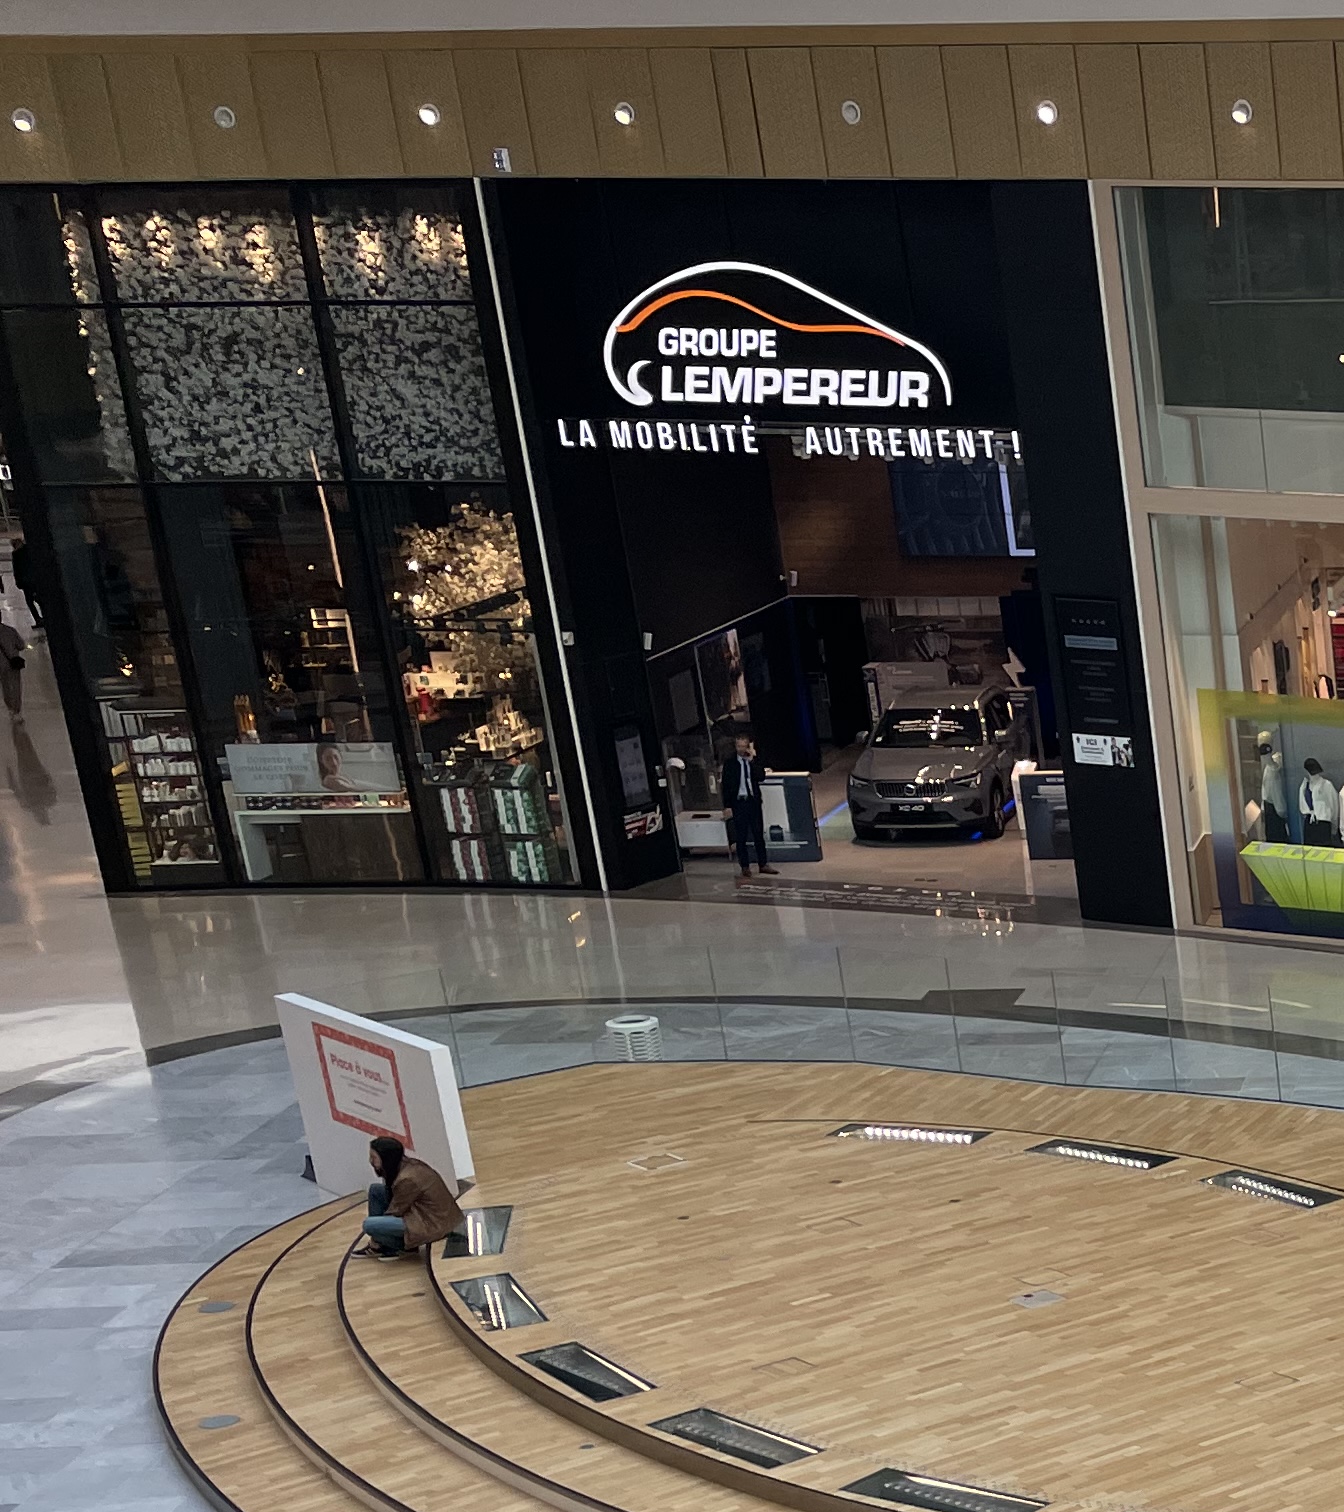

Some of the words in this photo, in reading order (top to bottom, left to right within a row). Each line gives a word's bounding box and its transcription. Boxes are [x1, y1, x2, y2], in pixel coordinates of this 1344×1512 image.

[658, 327, 777, 357] GROUPE
[661, 365, 930, 408] LEMPEREUR
[557, 418, 597, 448] LA
[608, 414, 759, 454] MOBILITÉ
[805, 426, 994, 459] AUTREMENT
